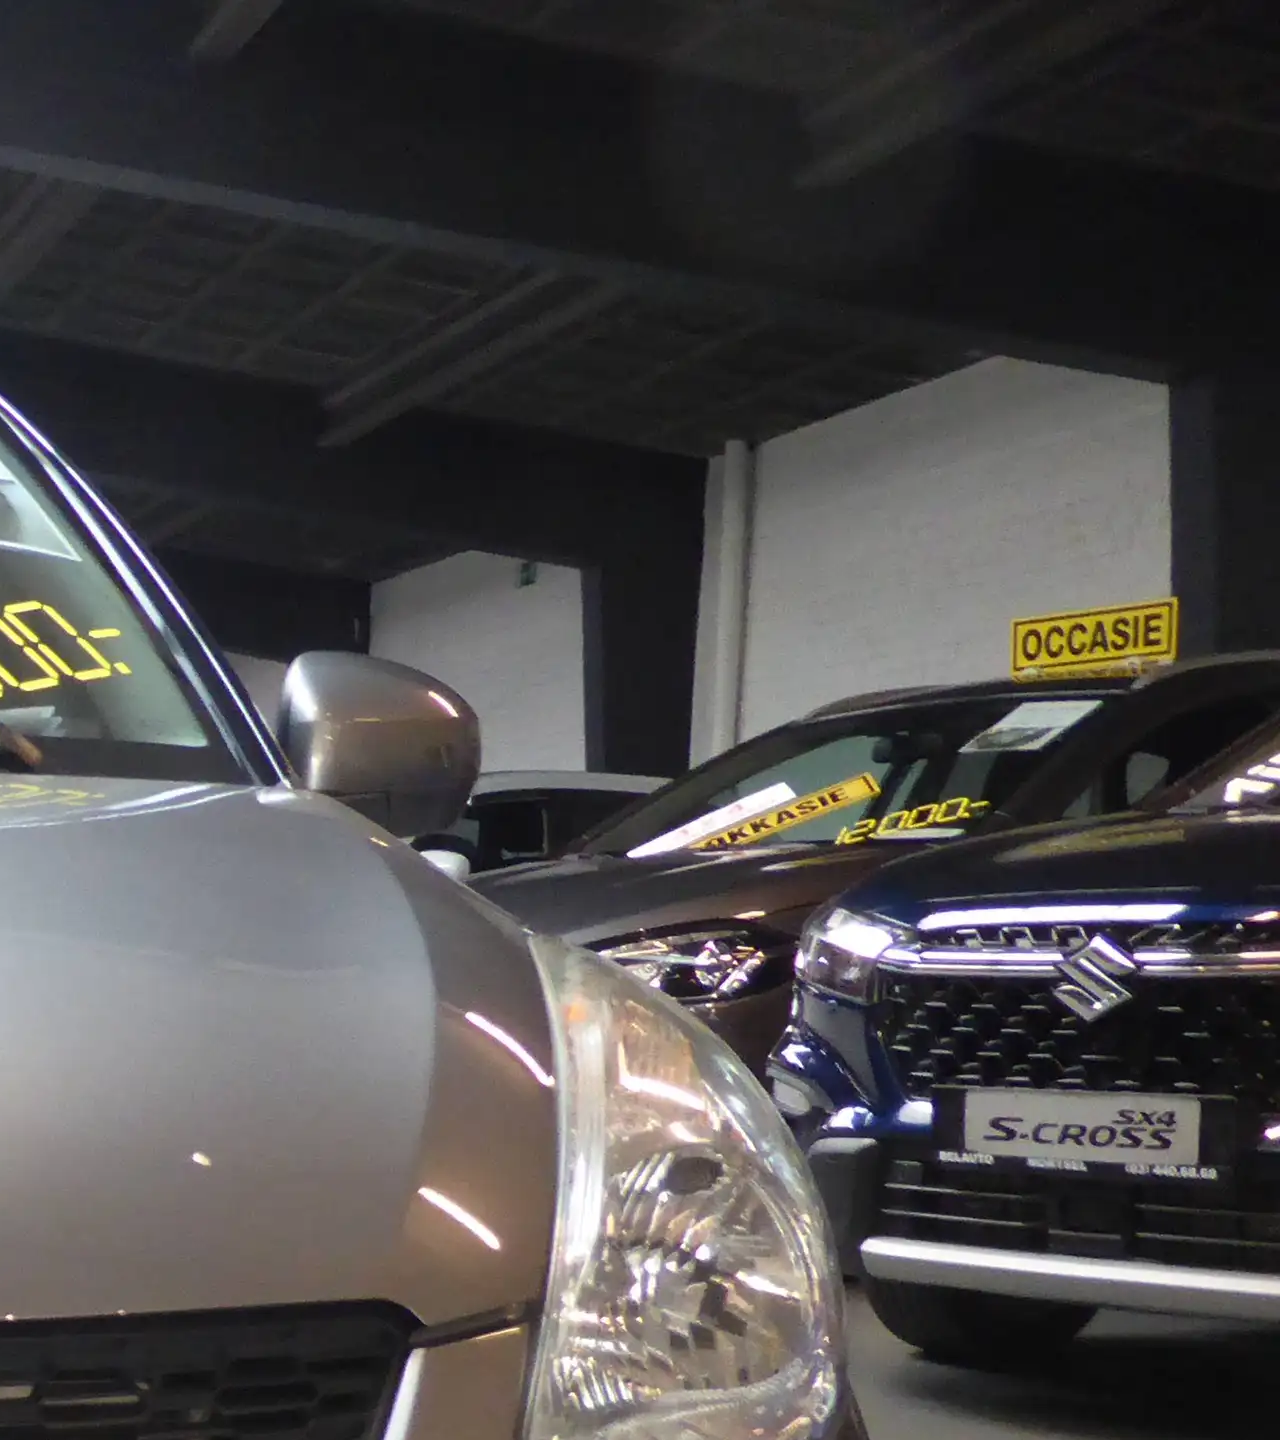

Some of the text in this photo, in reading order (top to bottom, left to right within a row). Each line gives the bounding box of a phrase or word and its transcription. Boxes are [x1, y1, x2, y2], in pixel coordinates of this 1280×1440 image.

[1021, 612, 1163, 661] OCCASIE
[703, 787, 848, 851] OKKASIE
[1112, 1108, 1177, 1126] SX4
